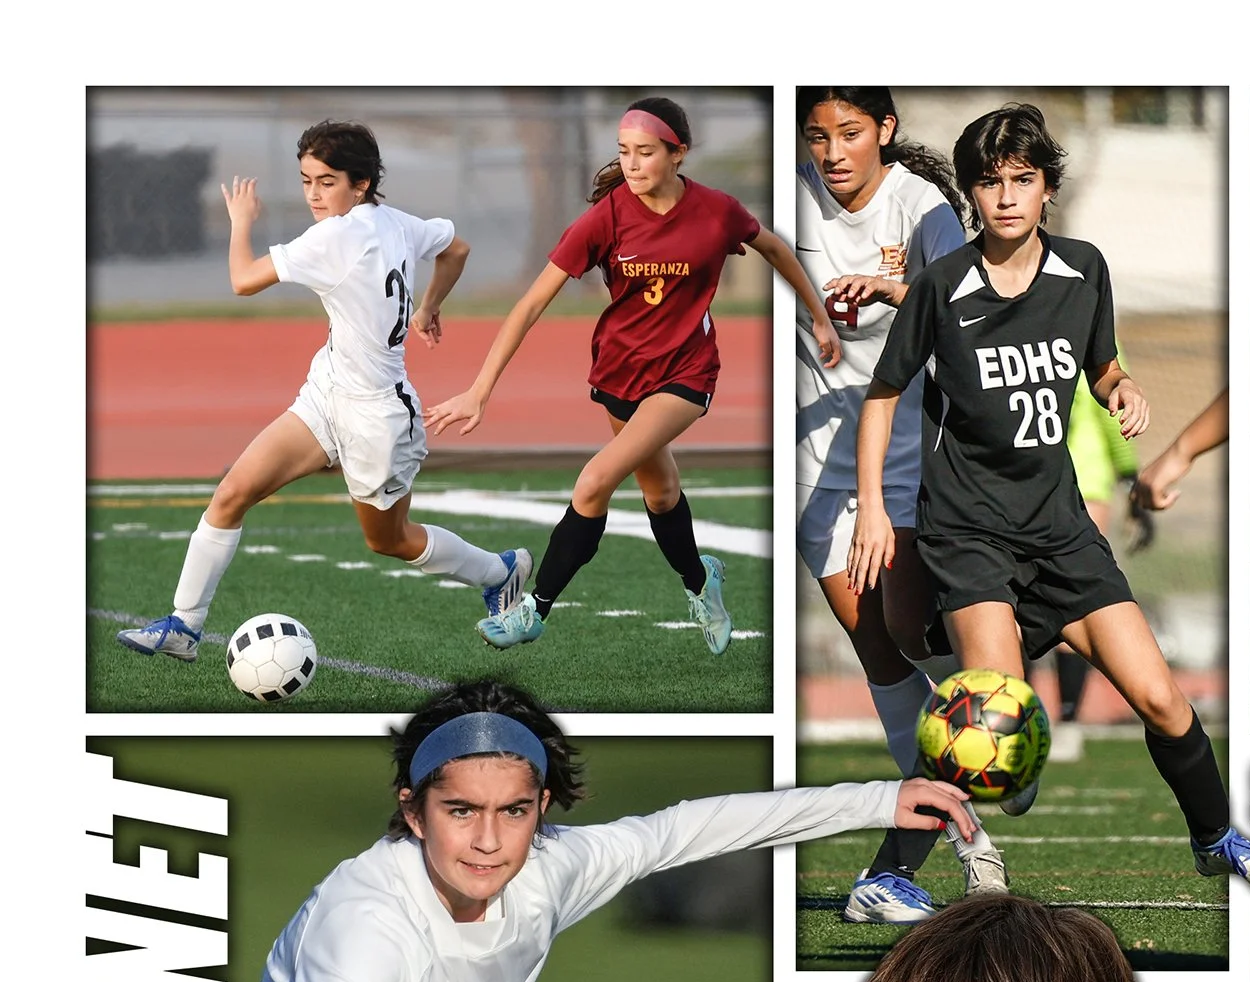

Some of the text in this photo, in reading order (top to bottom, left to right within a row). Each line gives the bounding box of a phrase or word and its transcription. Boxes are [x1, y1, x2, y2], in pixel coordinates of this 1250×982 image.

[621, 262, 690, 278] ESPERANZA
[643, 277, 665, 306] 3
[975, 338, 1077, 390] EDHS
[1008, 387, 1063, 448] 28
